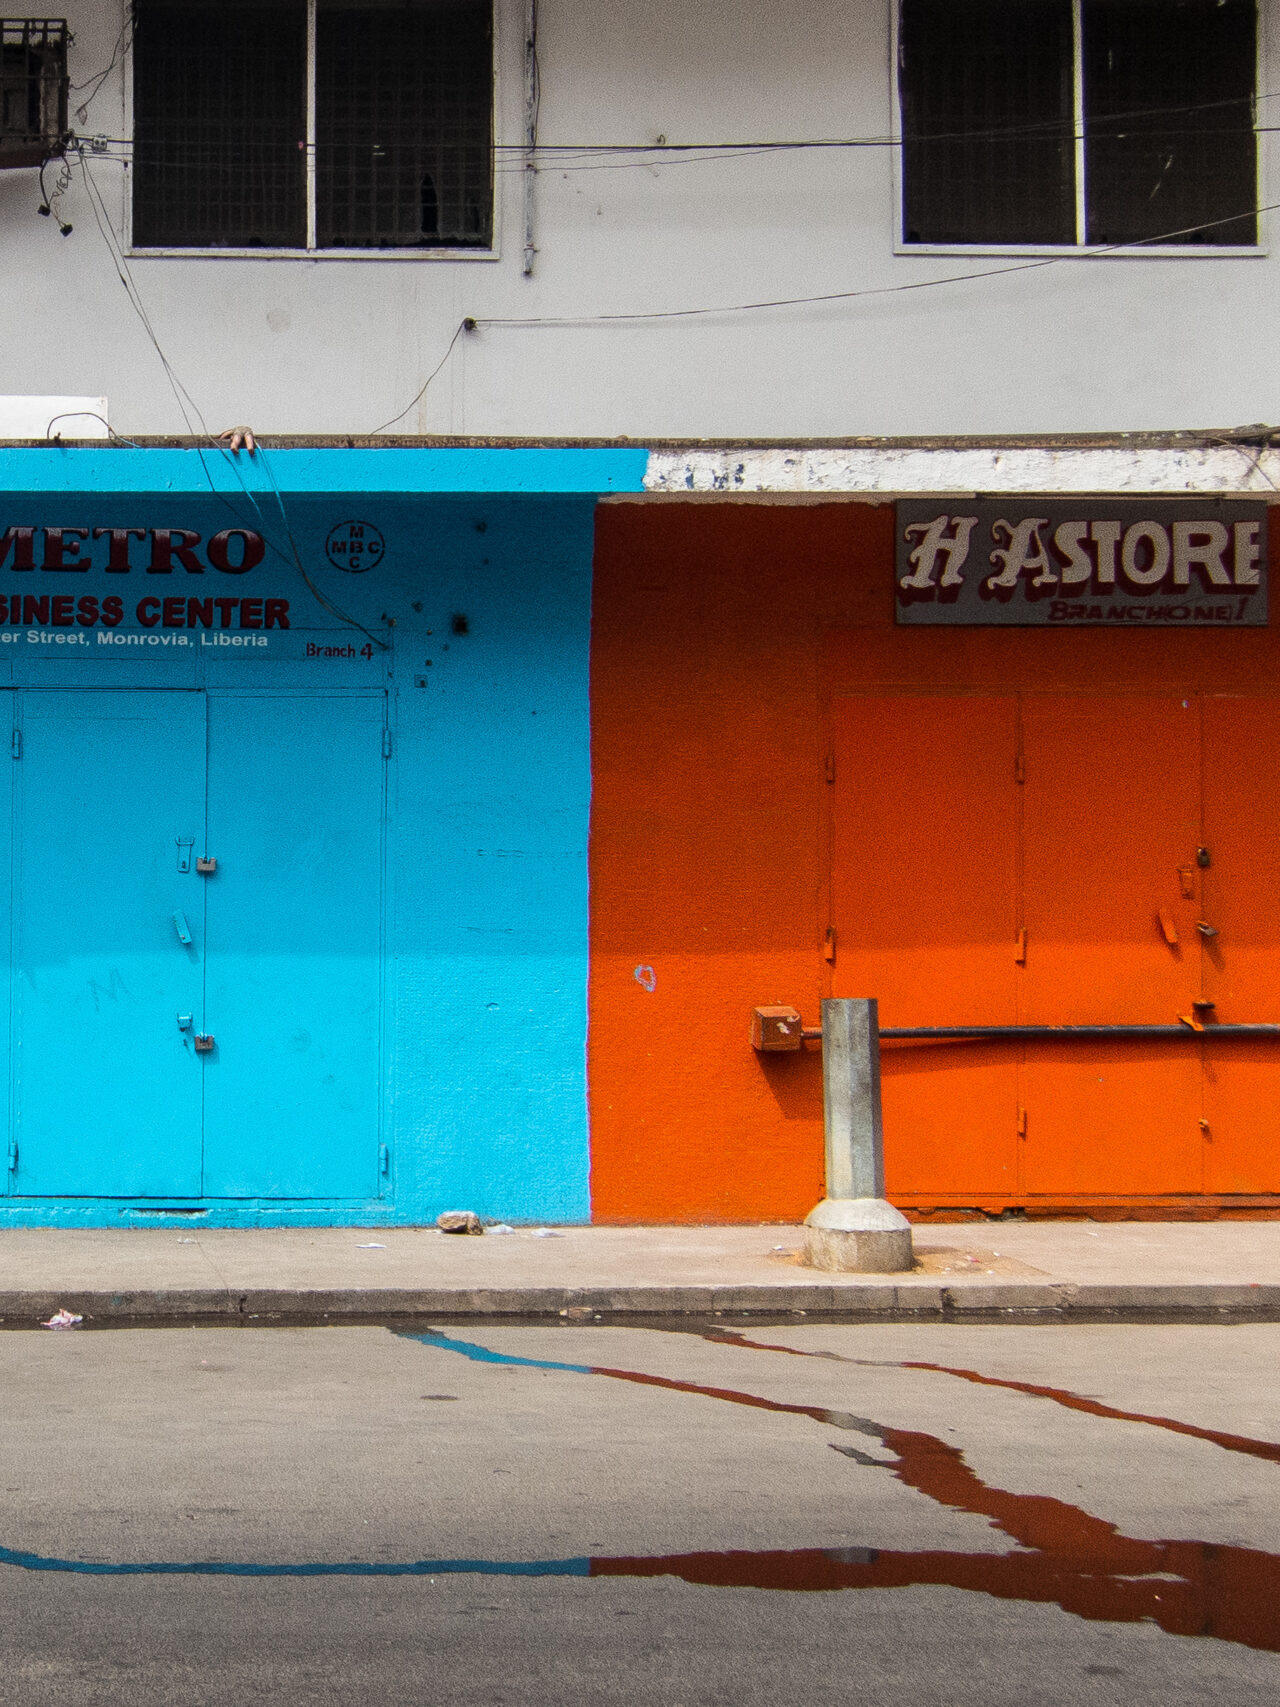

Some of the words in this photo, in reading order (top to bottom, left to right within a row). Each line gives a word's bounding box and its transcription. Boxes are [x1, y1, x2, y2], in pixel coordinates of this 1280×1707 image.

[899, 515, 978, 589] H
[136, 595, 291, 629] CENTER
[26, 630, 90, 646] Street,
[97, 631, 194, 647] Monrovia,
[201, 632, 268, 647] Liberia
[306, 642, 356, 657] Branch
[360, 643, 374, 660] 4
